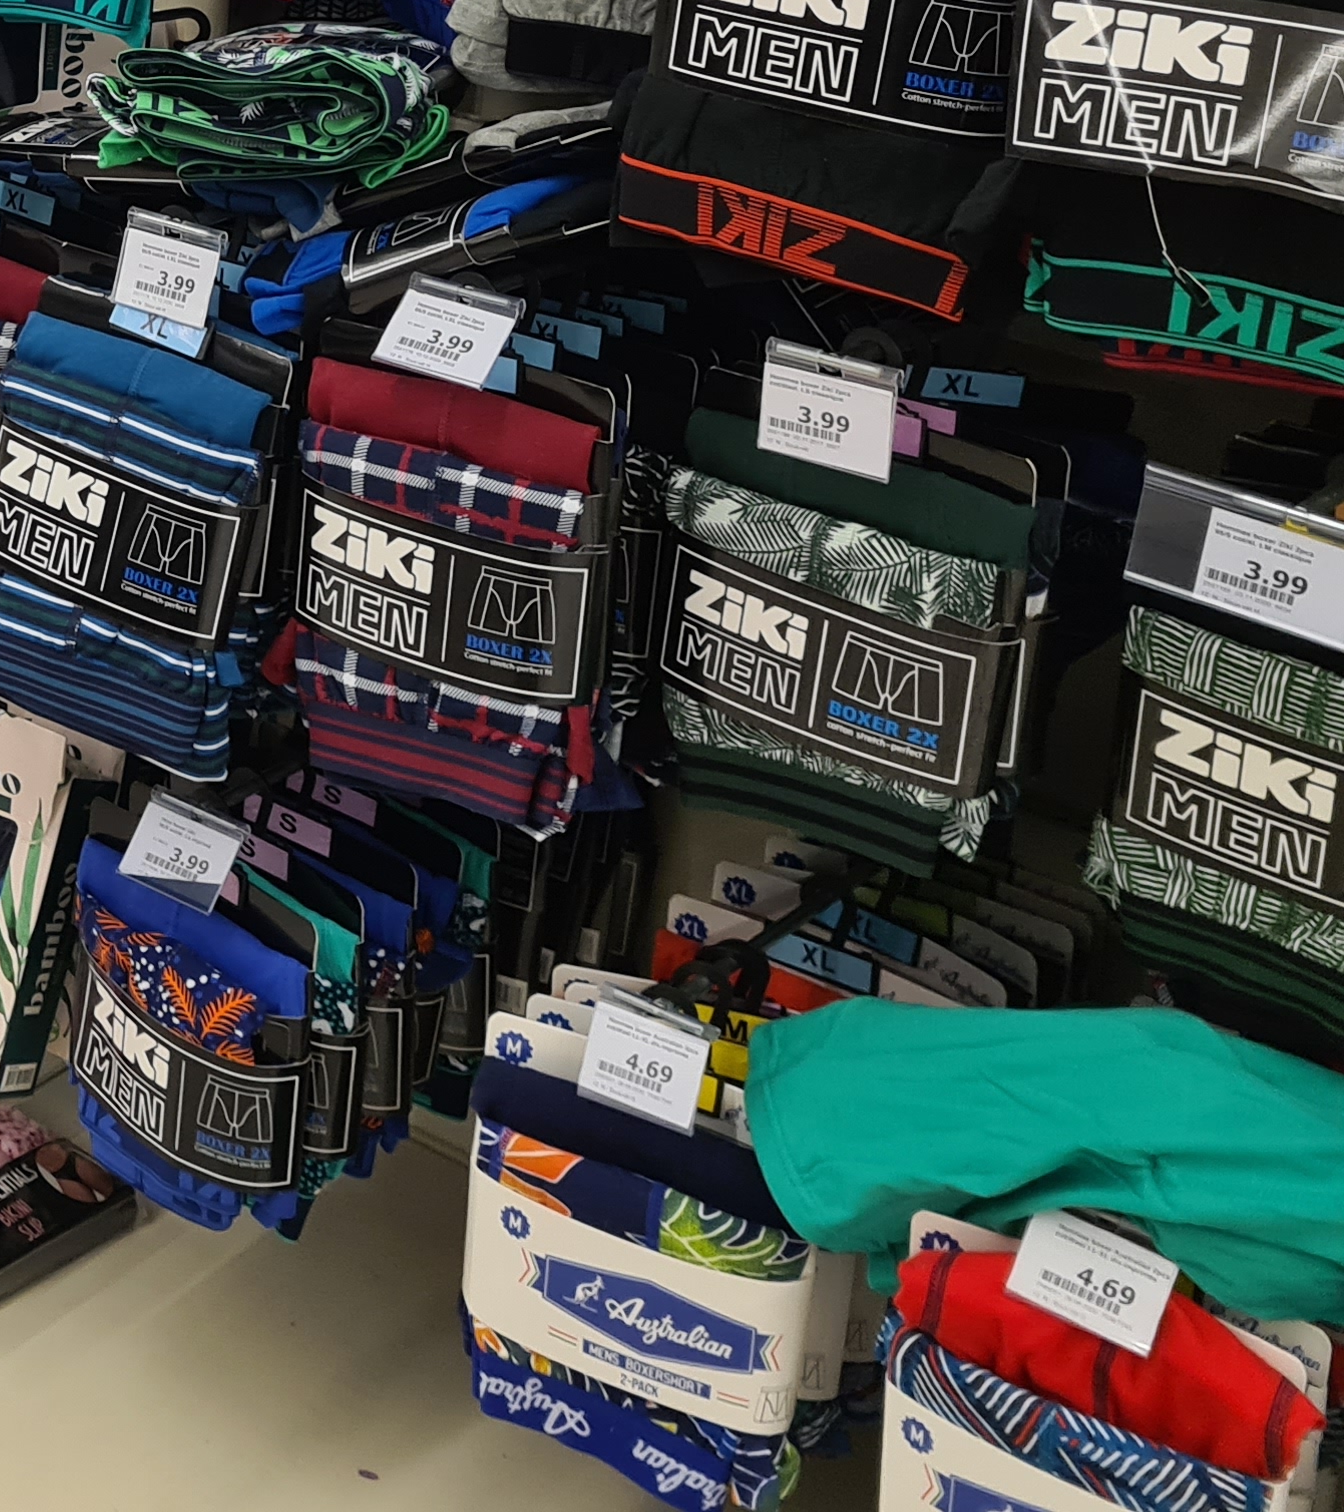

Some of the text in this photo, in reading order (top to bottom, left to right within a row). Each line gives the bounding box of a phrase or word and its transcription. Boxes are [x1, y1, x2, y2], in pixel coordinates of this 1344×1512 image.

[688, 14, 860, 103] MEN
[905, 71, 976, 99] BOXER
[1034, 76, 1237, 166] MEN
[5, 188, 29, 214] XL
[697, 182, 846, 275] ZIKI
[156, 270, 196, 294] 3.99
[140, 313, 168, 340] XL
[426, 329, 474, 354] 3.99
[941, 373, 980, 397] XL
[797, 405, 850, 433] 3.99
[123, 566, 199, 604] BOXER 2X
[1243, 559, 1309, 595] 3.99
[306, 563, 429, 657] MEN
[463, 651, 489, 665] Cotton
[465, 633, 553, 665] BOXER 2X
[676, 620, 802, 717] MEN
[828, 699, 940, 750] BOXER 2X
[826, 720, 855, 737] cotton
[924, 751, 937, 764] fit
[324, 785, 342, 804] S
[279, 813, 297, 834] S
[1147, 770, 1327, 890] MEN
[168, 847, 209, 875] 3.99
[24, 862, 78, 1017] bamboo
[801, 942, 836, 977] XL
[505, 1036, 522, 1058] M
[625, 1052, 673, 1084] 4.69
[508, 1212, 522, 1234] M
[1076, 1266, 1136, 1306] 4.69
[606, 1296, 733, 1361] Australian
[588, 1342, 705, 1397] MENS BOXERSHORT
[620, 1372, 660, 1398] 2-PACK
[911, 1430, 924, 1447] M
